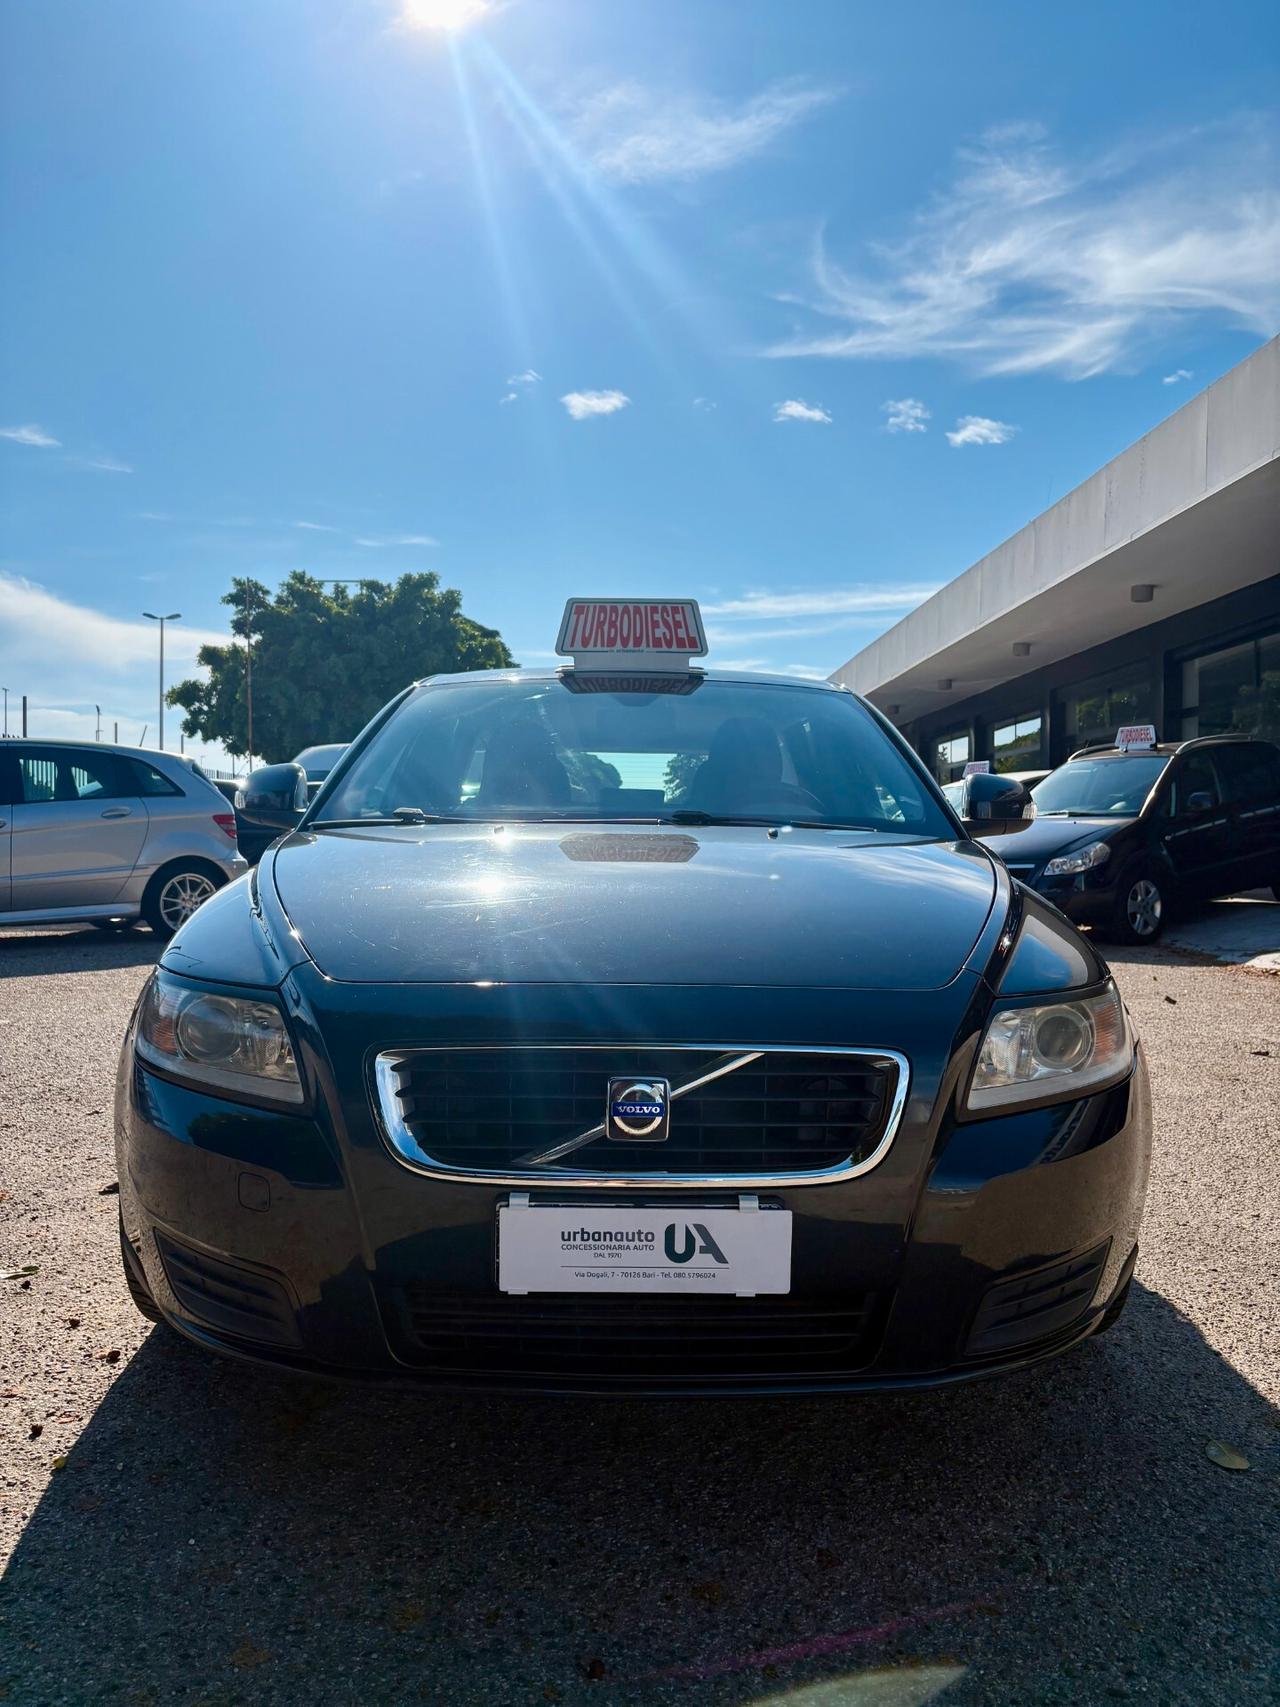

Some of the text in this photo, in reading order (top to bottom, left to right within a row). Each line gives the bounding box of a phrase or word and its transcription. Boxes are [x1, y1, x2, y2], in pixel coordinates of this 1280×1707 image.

[570, 605, 698, 649] TURBODIESEL
[617, 1106, 661, 1114] VOLVO
[561, 1228, 655, 1242] urbanauto
[620, 1271, 641, 1279] 70126
[642, 1271, 656, 1279] Bari
